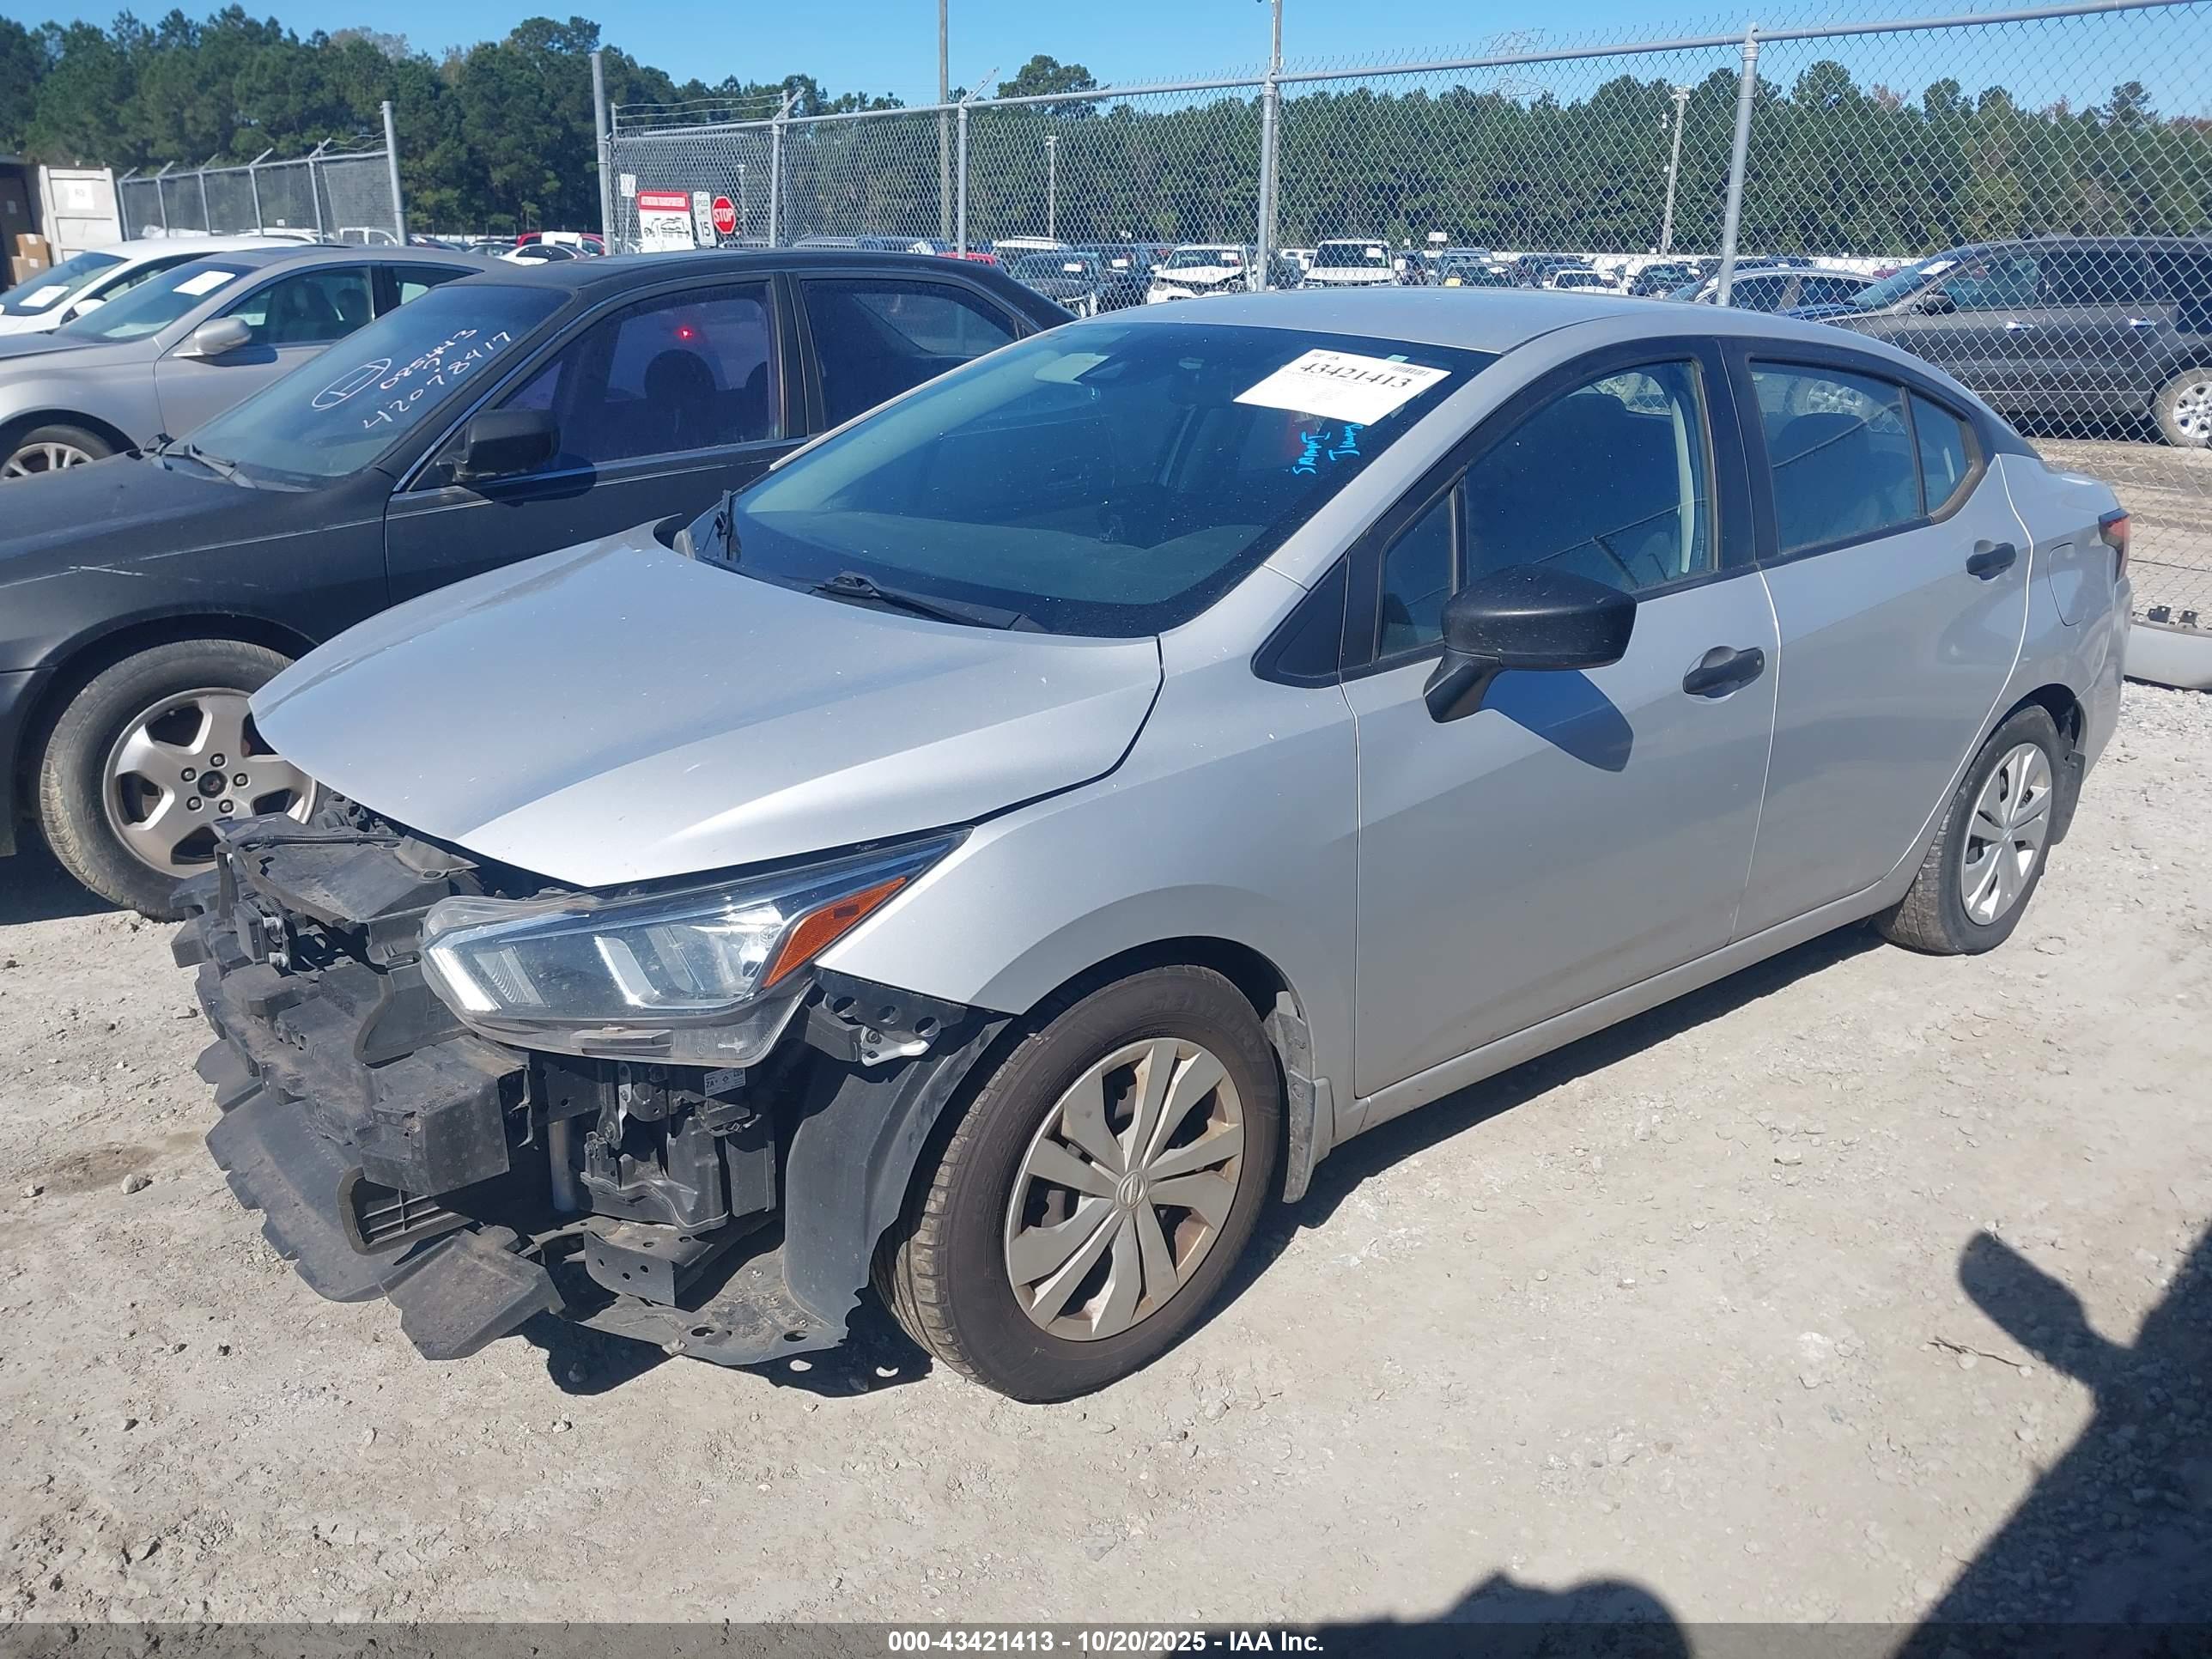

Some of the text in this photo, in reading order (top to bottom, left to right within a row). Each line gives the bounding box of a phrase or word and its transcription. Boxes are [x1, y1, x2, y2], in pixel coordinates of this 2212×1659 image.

[714, 207, 733, 222] STOP
[700, 222, 711, 237] 15
[363, 331, 512, 429] 42078417
[1300, 362, 1413, 387] 43421413
